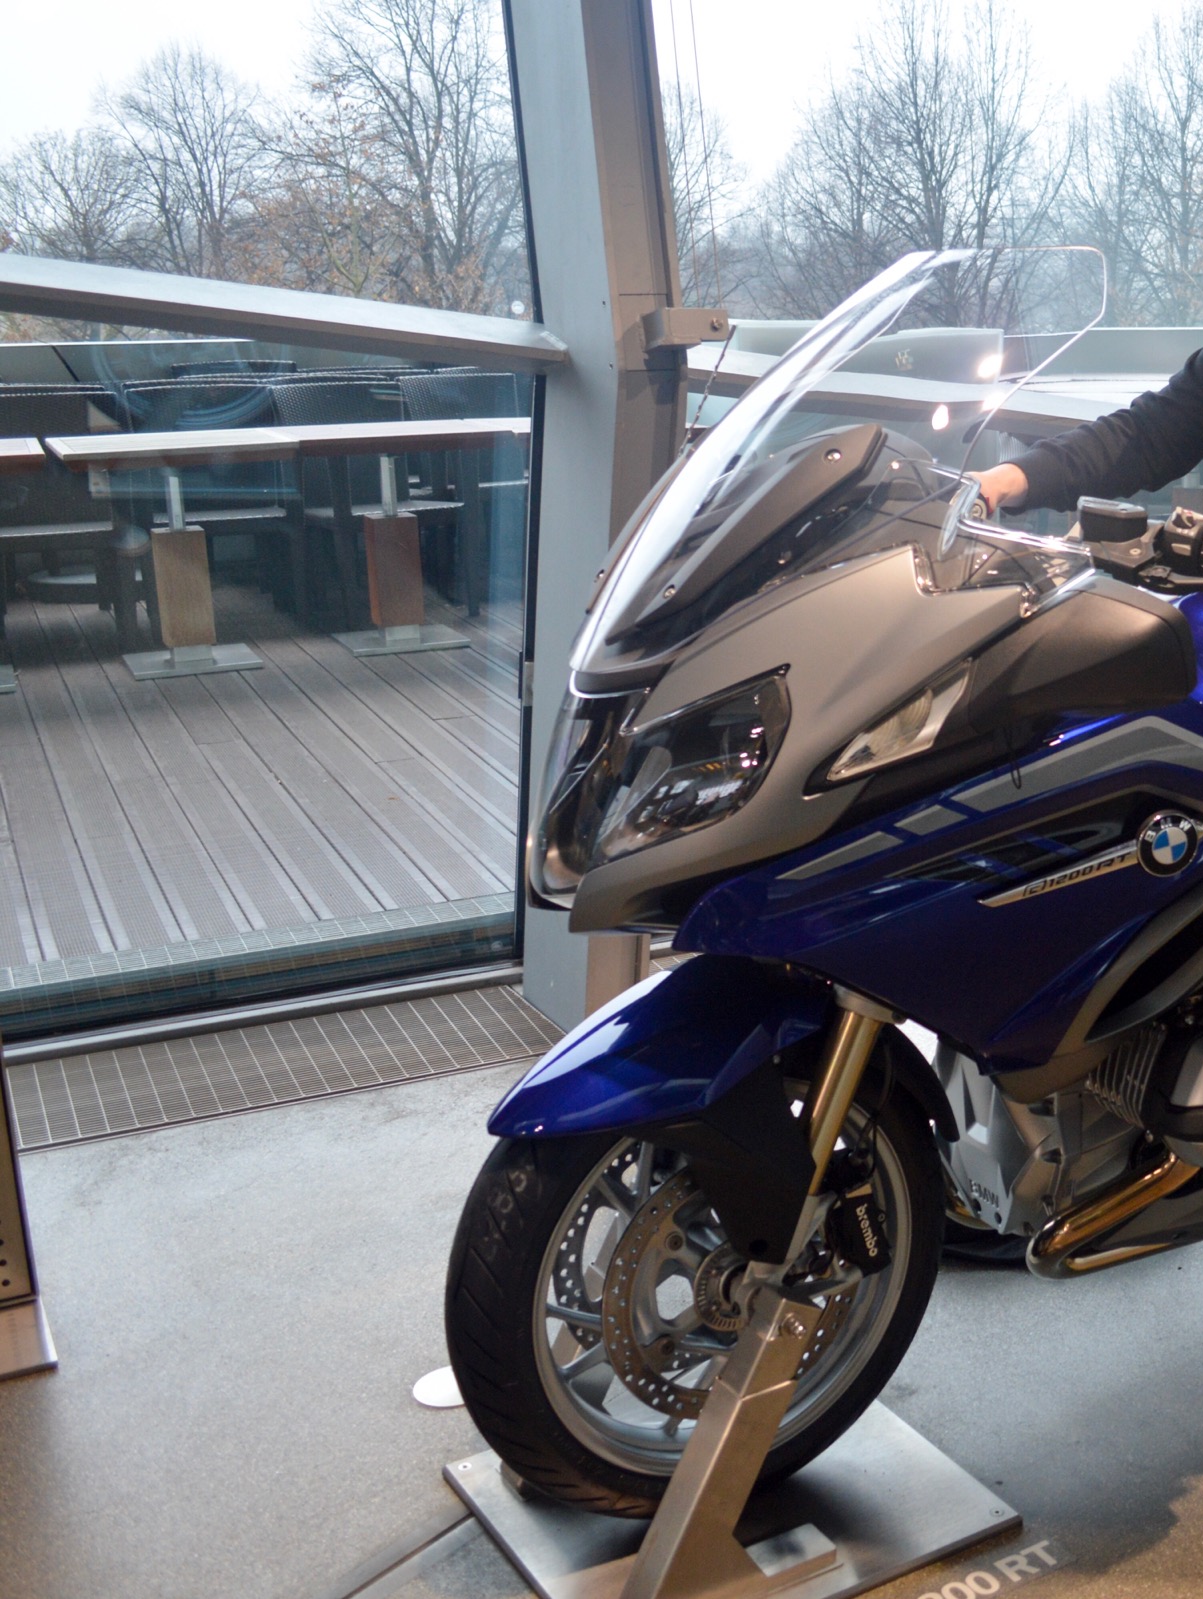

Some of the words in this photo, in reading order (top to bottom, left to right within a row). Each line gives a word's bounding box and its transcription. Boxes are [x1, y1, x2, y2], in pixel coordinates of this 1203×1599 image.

[1143, 817, 1192, 843] BMW
[969, 1179, 1000, 1209] BMW
[855, 1202, 879, 1258] brembo
[993, 1539, 1058, 1583] RT
